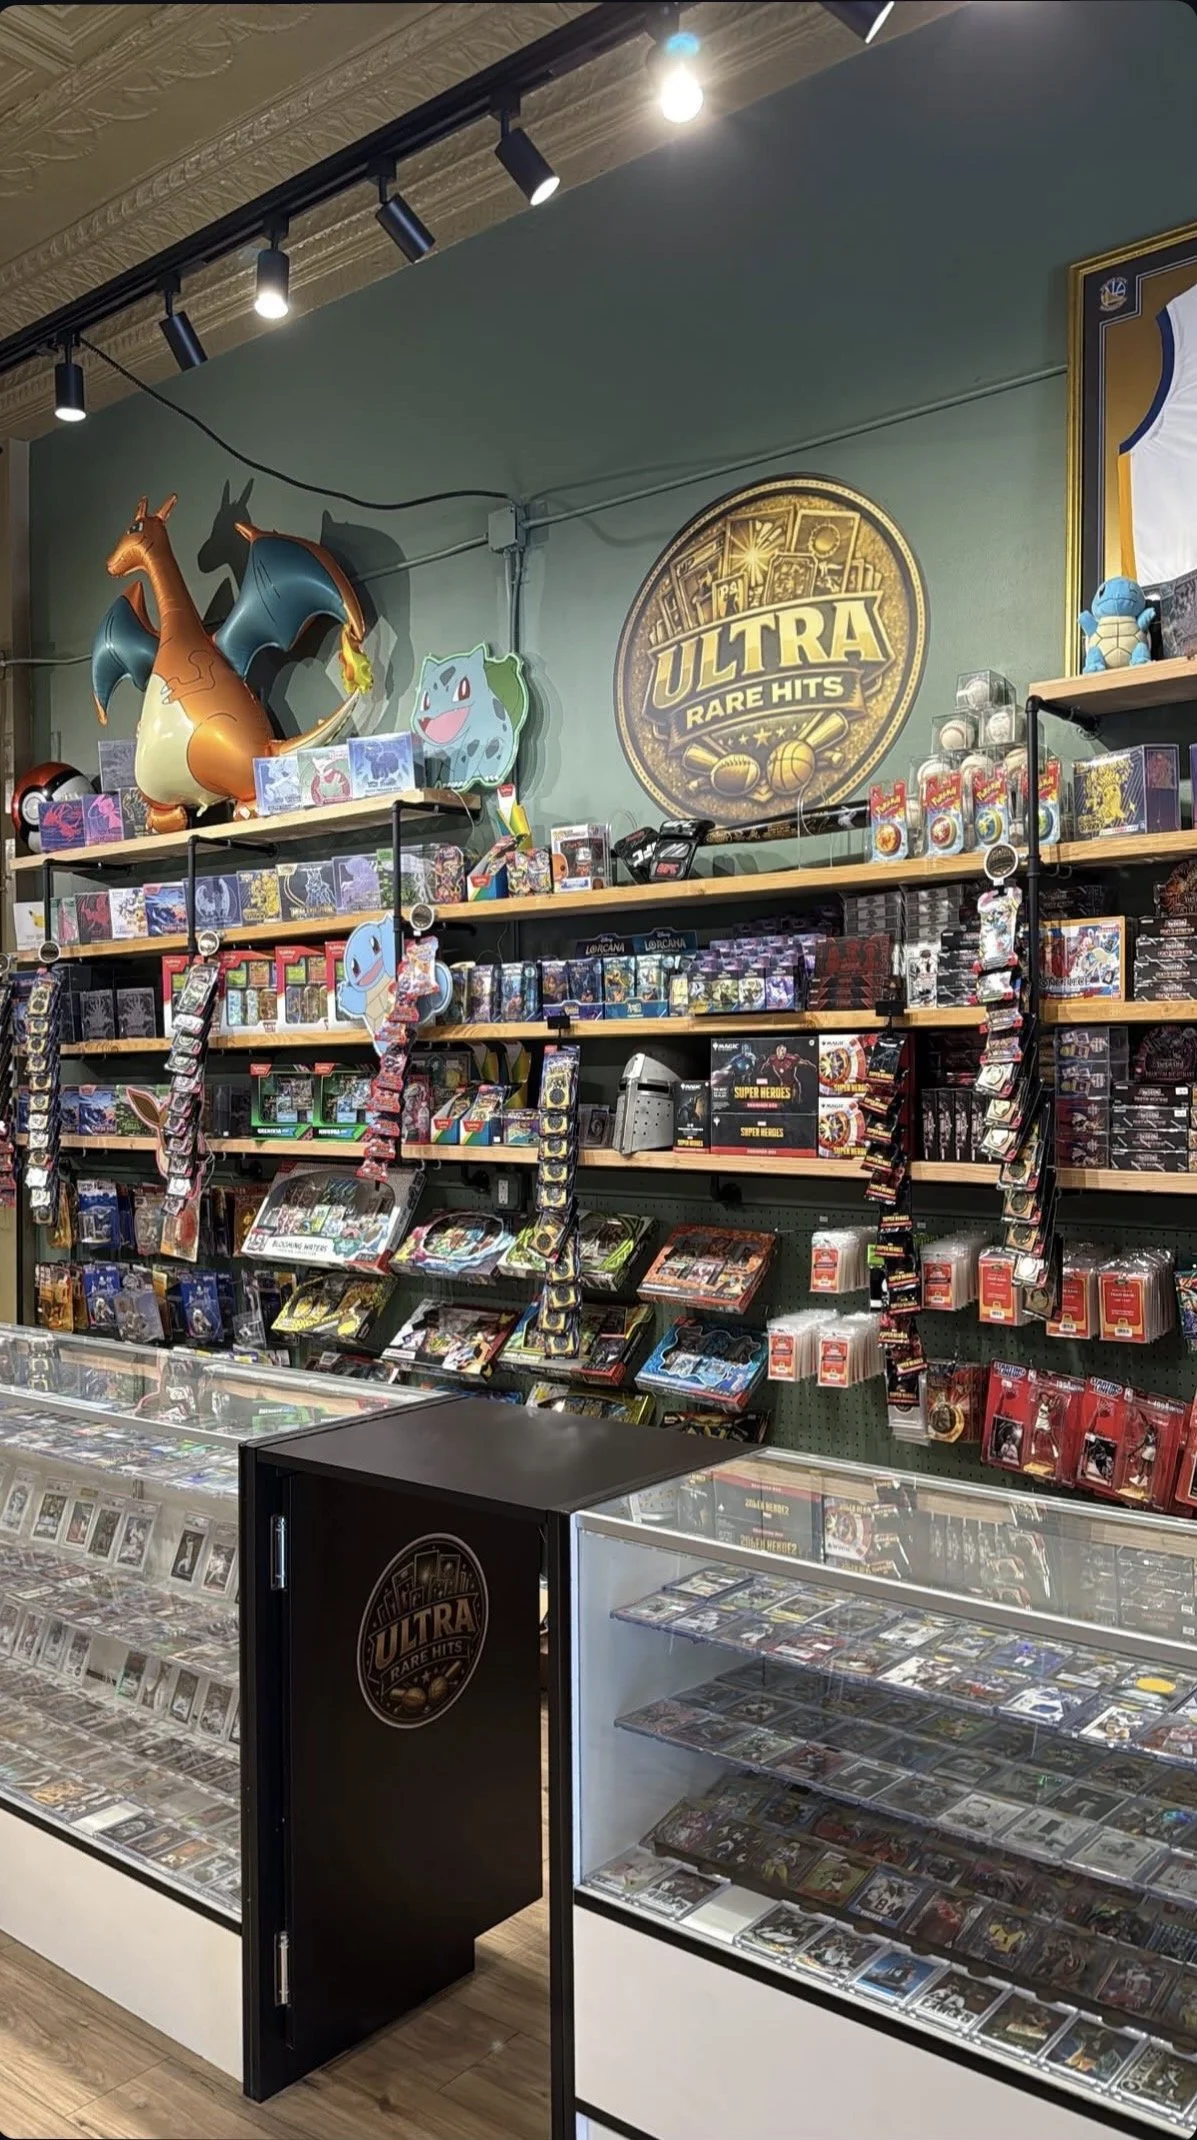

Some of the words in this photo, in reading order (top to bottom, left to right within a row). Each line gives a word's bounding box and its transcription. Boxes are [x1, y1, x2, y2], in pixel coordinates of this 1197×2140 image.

[653, 597, 887, 710] ULTRA
[686, 685, 765, 730] RARE
[771, 675, 845, 707] HITS
[585, 942, 625, 955] LORCANA
[644, 939, 687, 951] LORCANA
[734, 1086, 759, 1099] SUPER
[760, 1086, 791, 1099] HEROES
[740, 1127, 759, 1137] SUPER
[760, 1127, 784, 1138] HEROES
[271, 1240, 301, 1250] BLOOMING
[303, 1243, 328, 1253] WATERS
[374, 1597, 477, 1671] ULTRA
[390, 1651, 429, 1682] RARE
[431, 1640, 464, 1660] HITS
